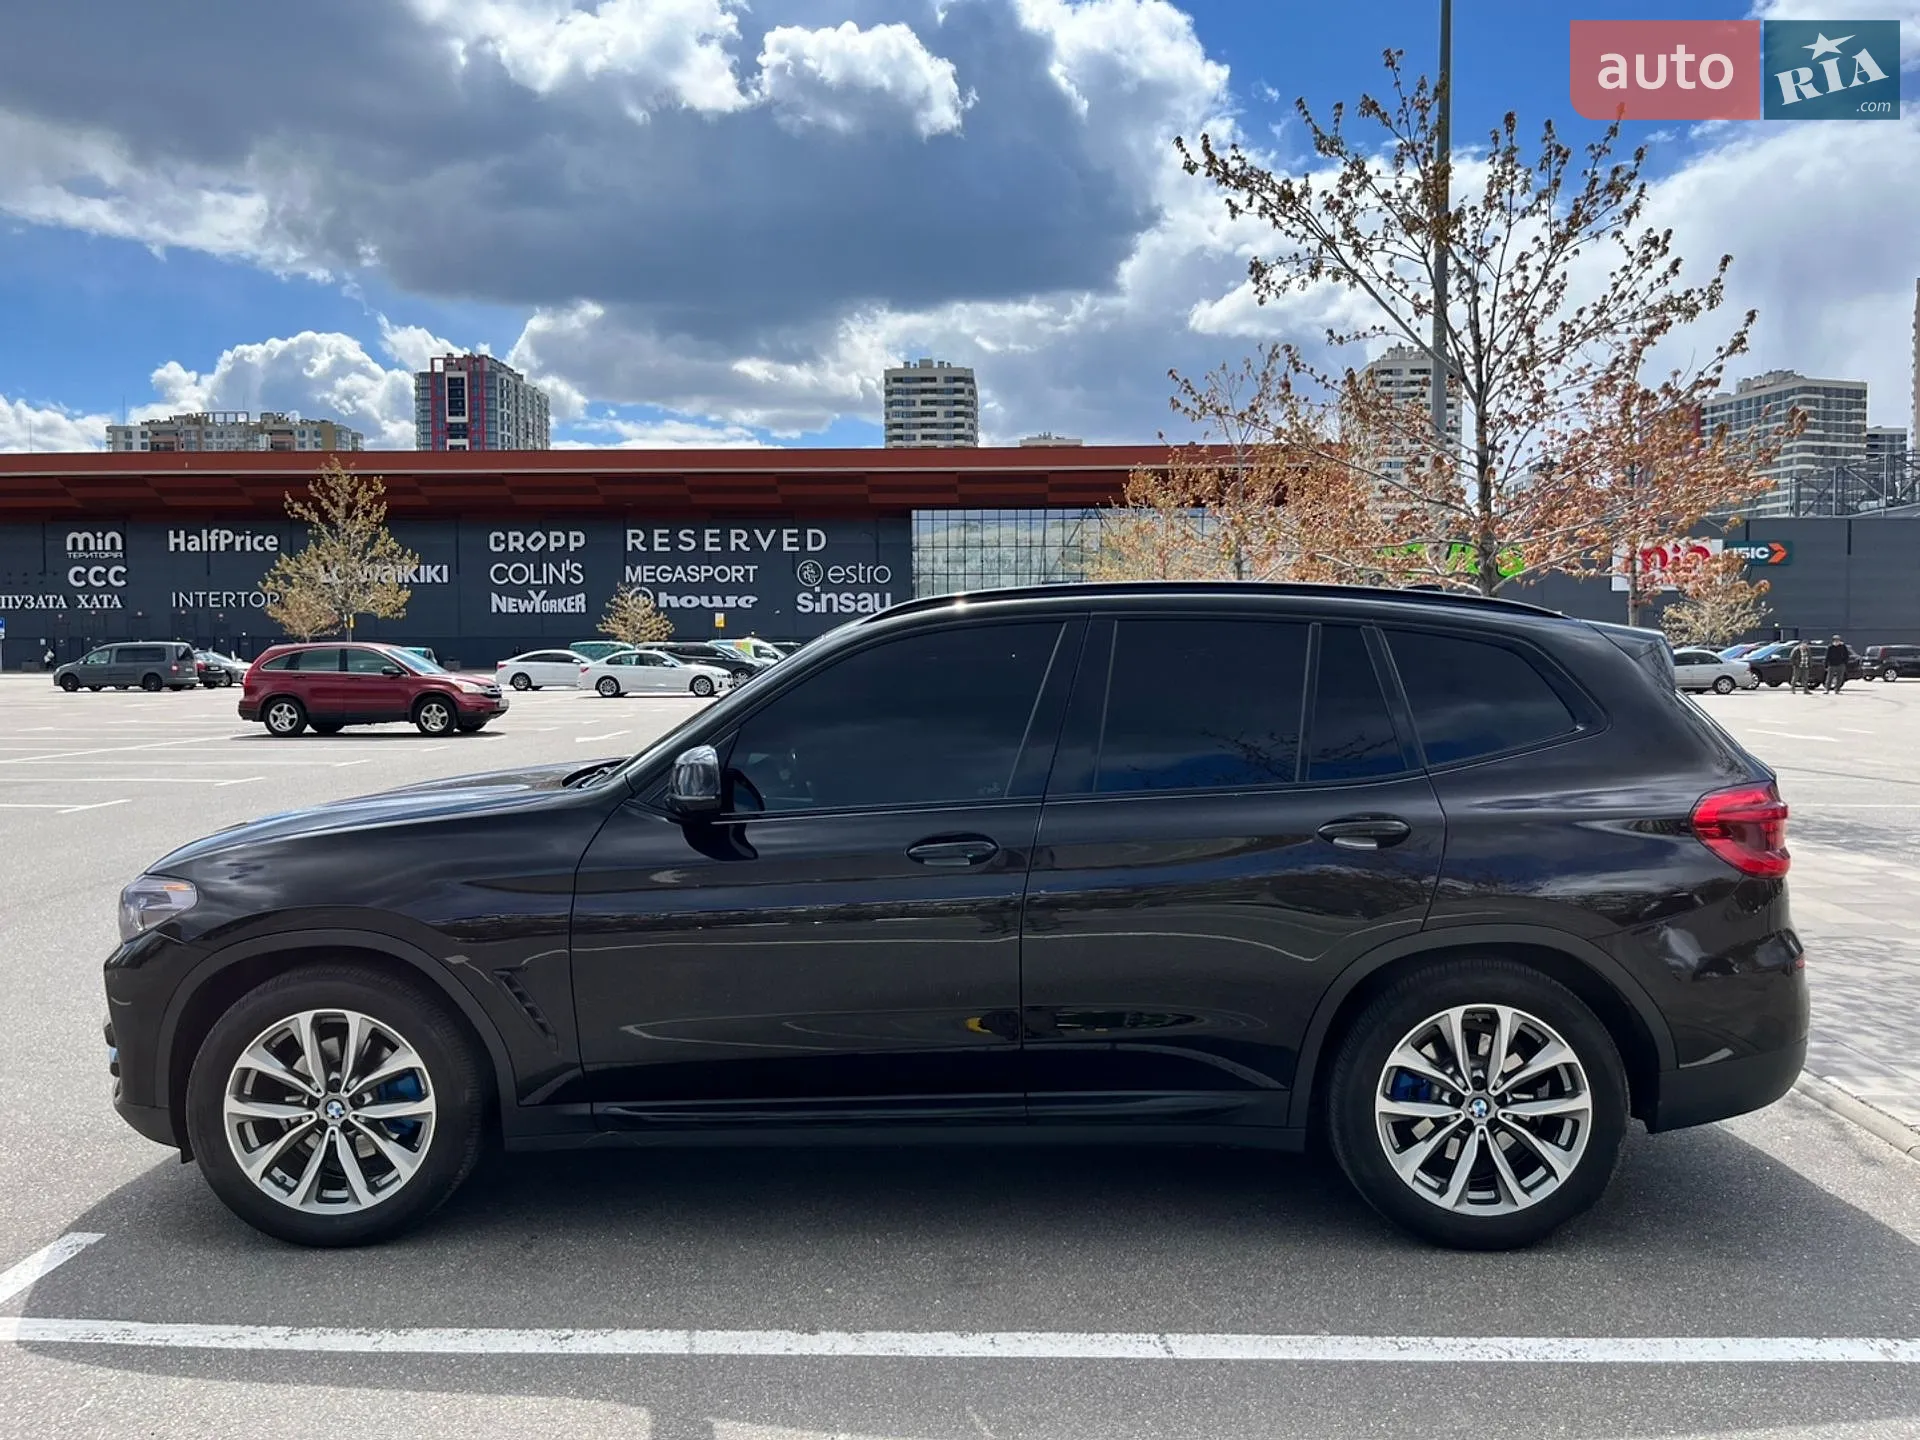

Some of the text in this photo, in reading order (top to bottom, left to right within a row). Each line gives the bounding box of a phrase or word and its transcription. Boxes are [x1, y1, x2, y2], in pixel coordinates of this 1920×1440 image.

[168, 529, 279, 552] HalfPrice
[489, 531, 586, 552] CROPP
[626, 529, 827, 552] RESERVED
[490, 559, 584, 585] COLIN'S
[625, 565, 759, 583] MEGASPORT
[827, 562, 892, 584] estro
[0, 594, 123, 609] ПУЗАТА ХАТА
[172, 591, 280, 608] INTERTOP
[658, 592, 758, 608] house
